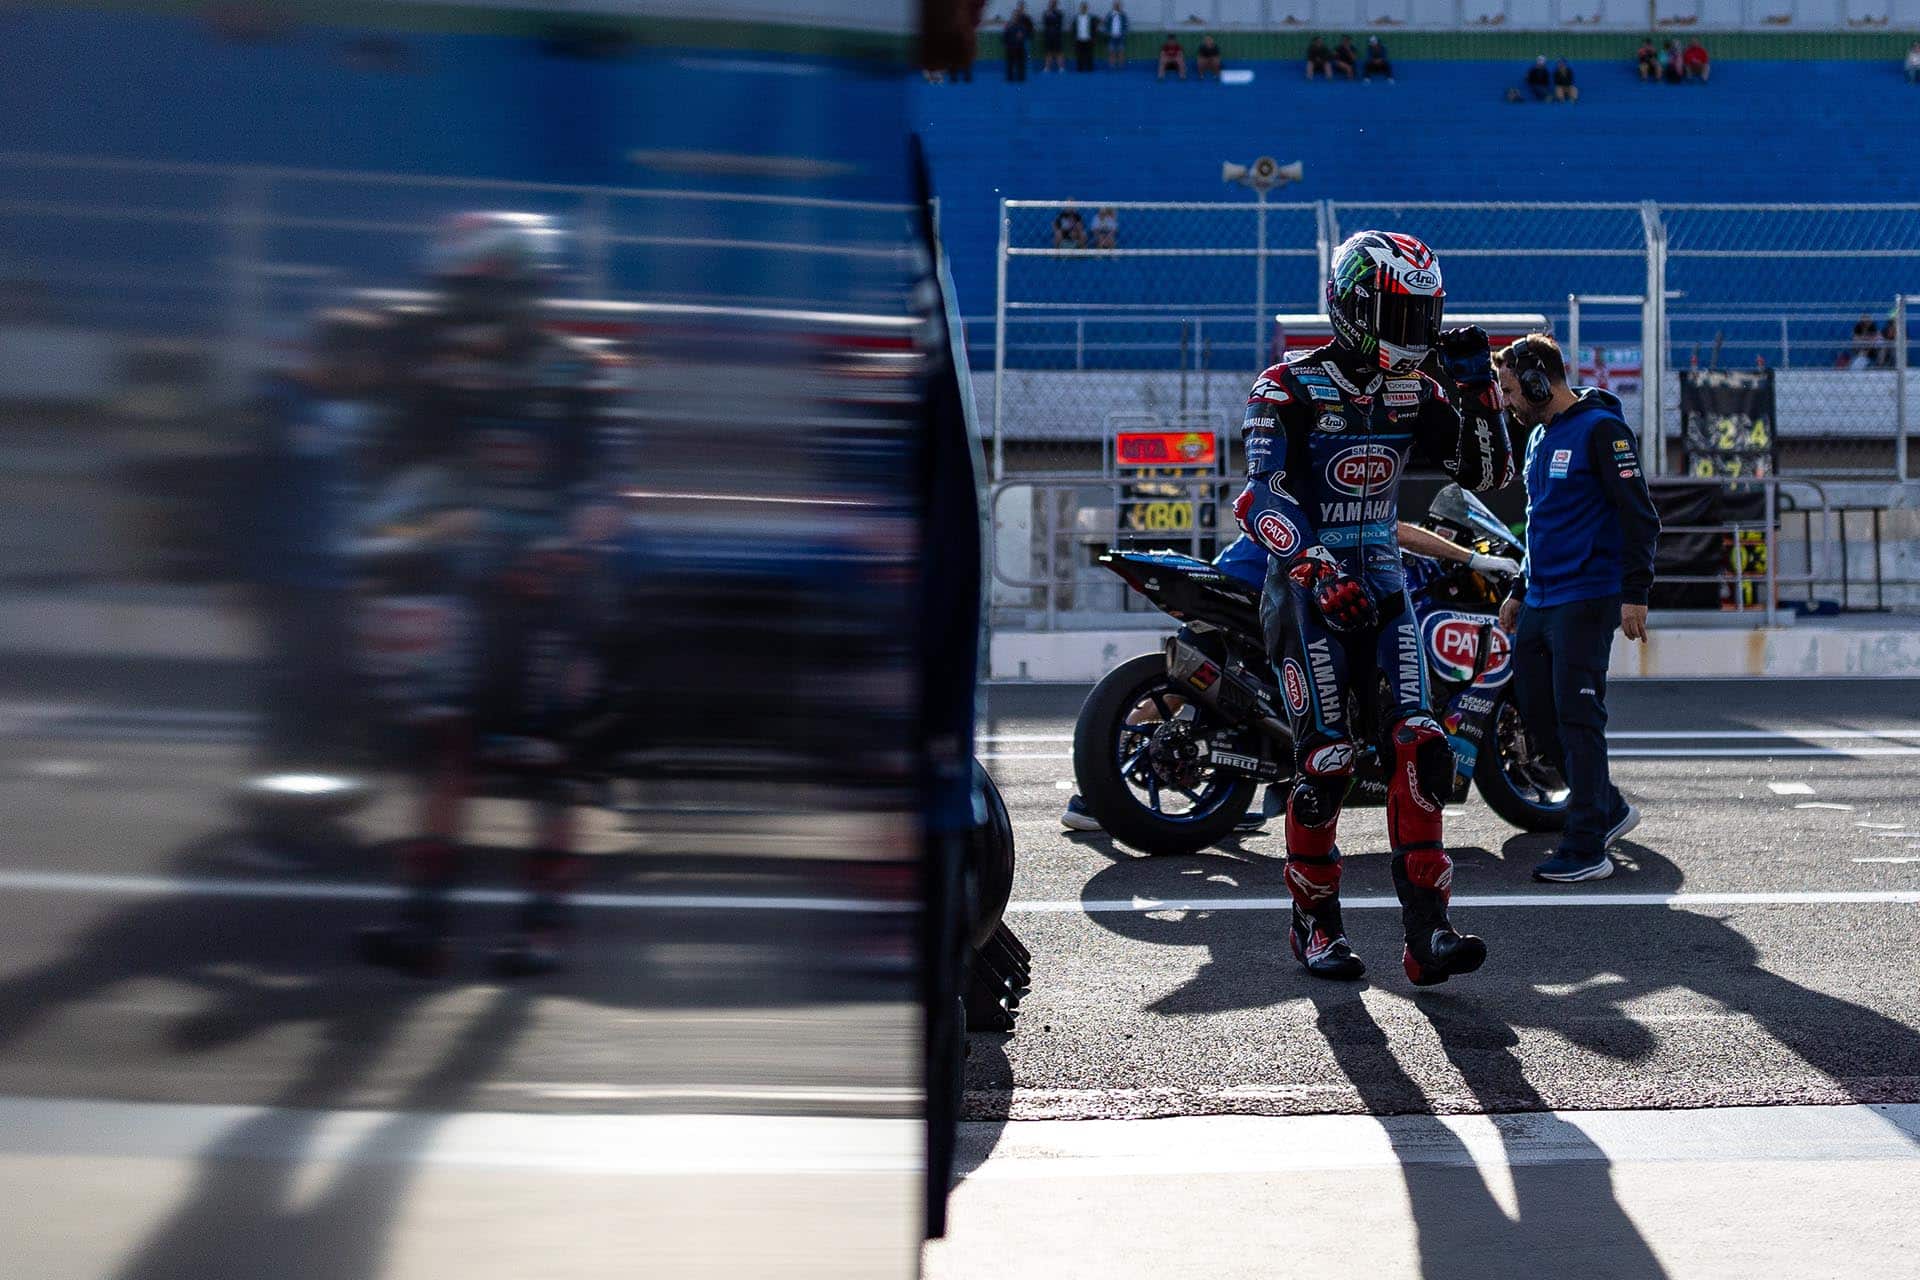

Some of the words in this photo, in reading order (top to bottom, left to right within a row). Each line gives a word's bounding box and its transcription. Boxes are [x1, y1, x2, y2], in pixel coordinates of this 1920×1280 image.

[1410, 270, 1437, 287] Arai
[1344, 461, 1387, 480] PATA
[1320, 500, 1391, 523] YAMAHA
[1262, 518, 1289, 547] PATA
[1398, 623, 1420, 705] YAMAHA
[1287, 670, 1300, 703] PATA
[1308, 637, 1342, 725] YAMAHA
[1211, 751, 1259, 771] PIRELLI
